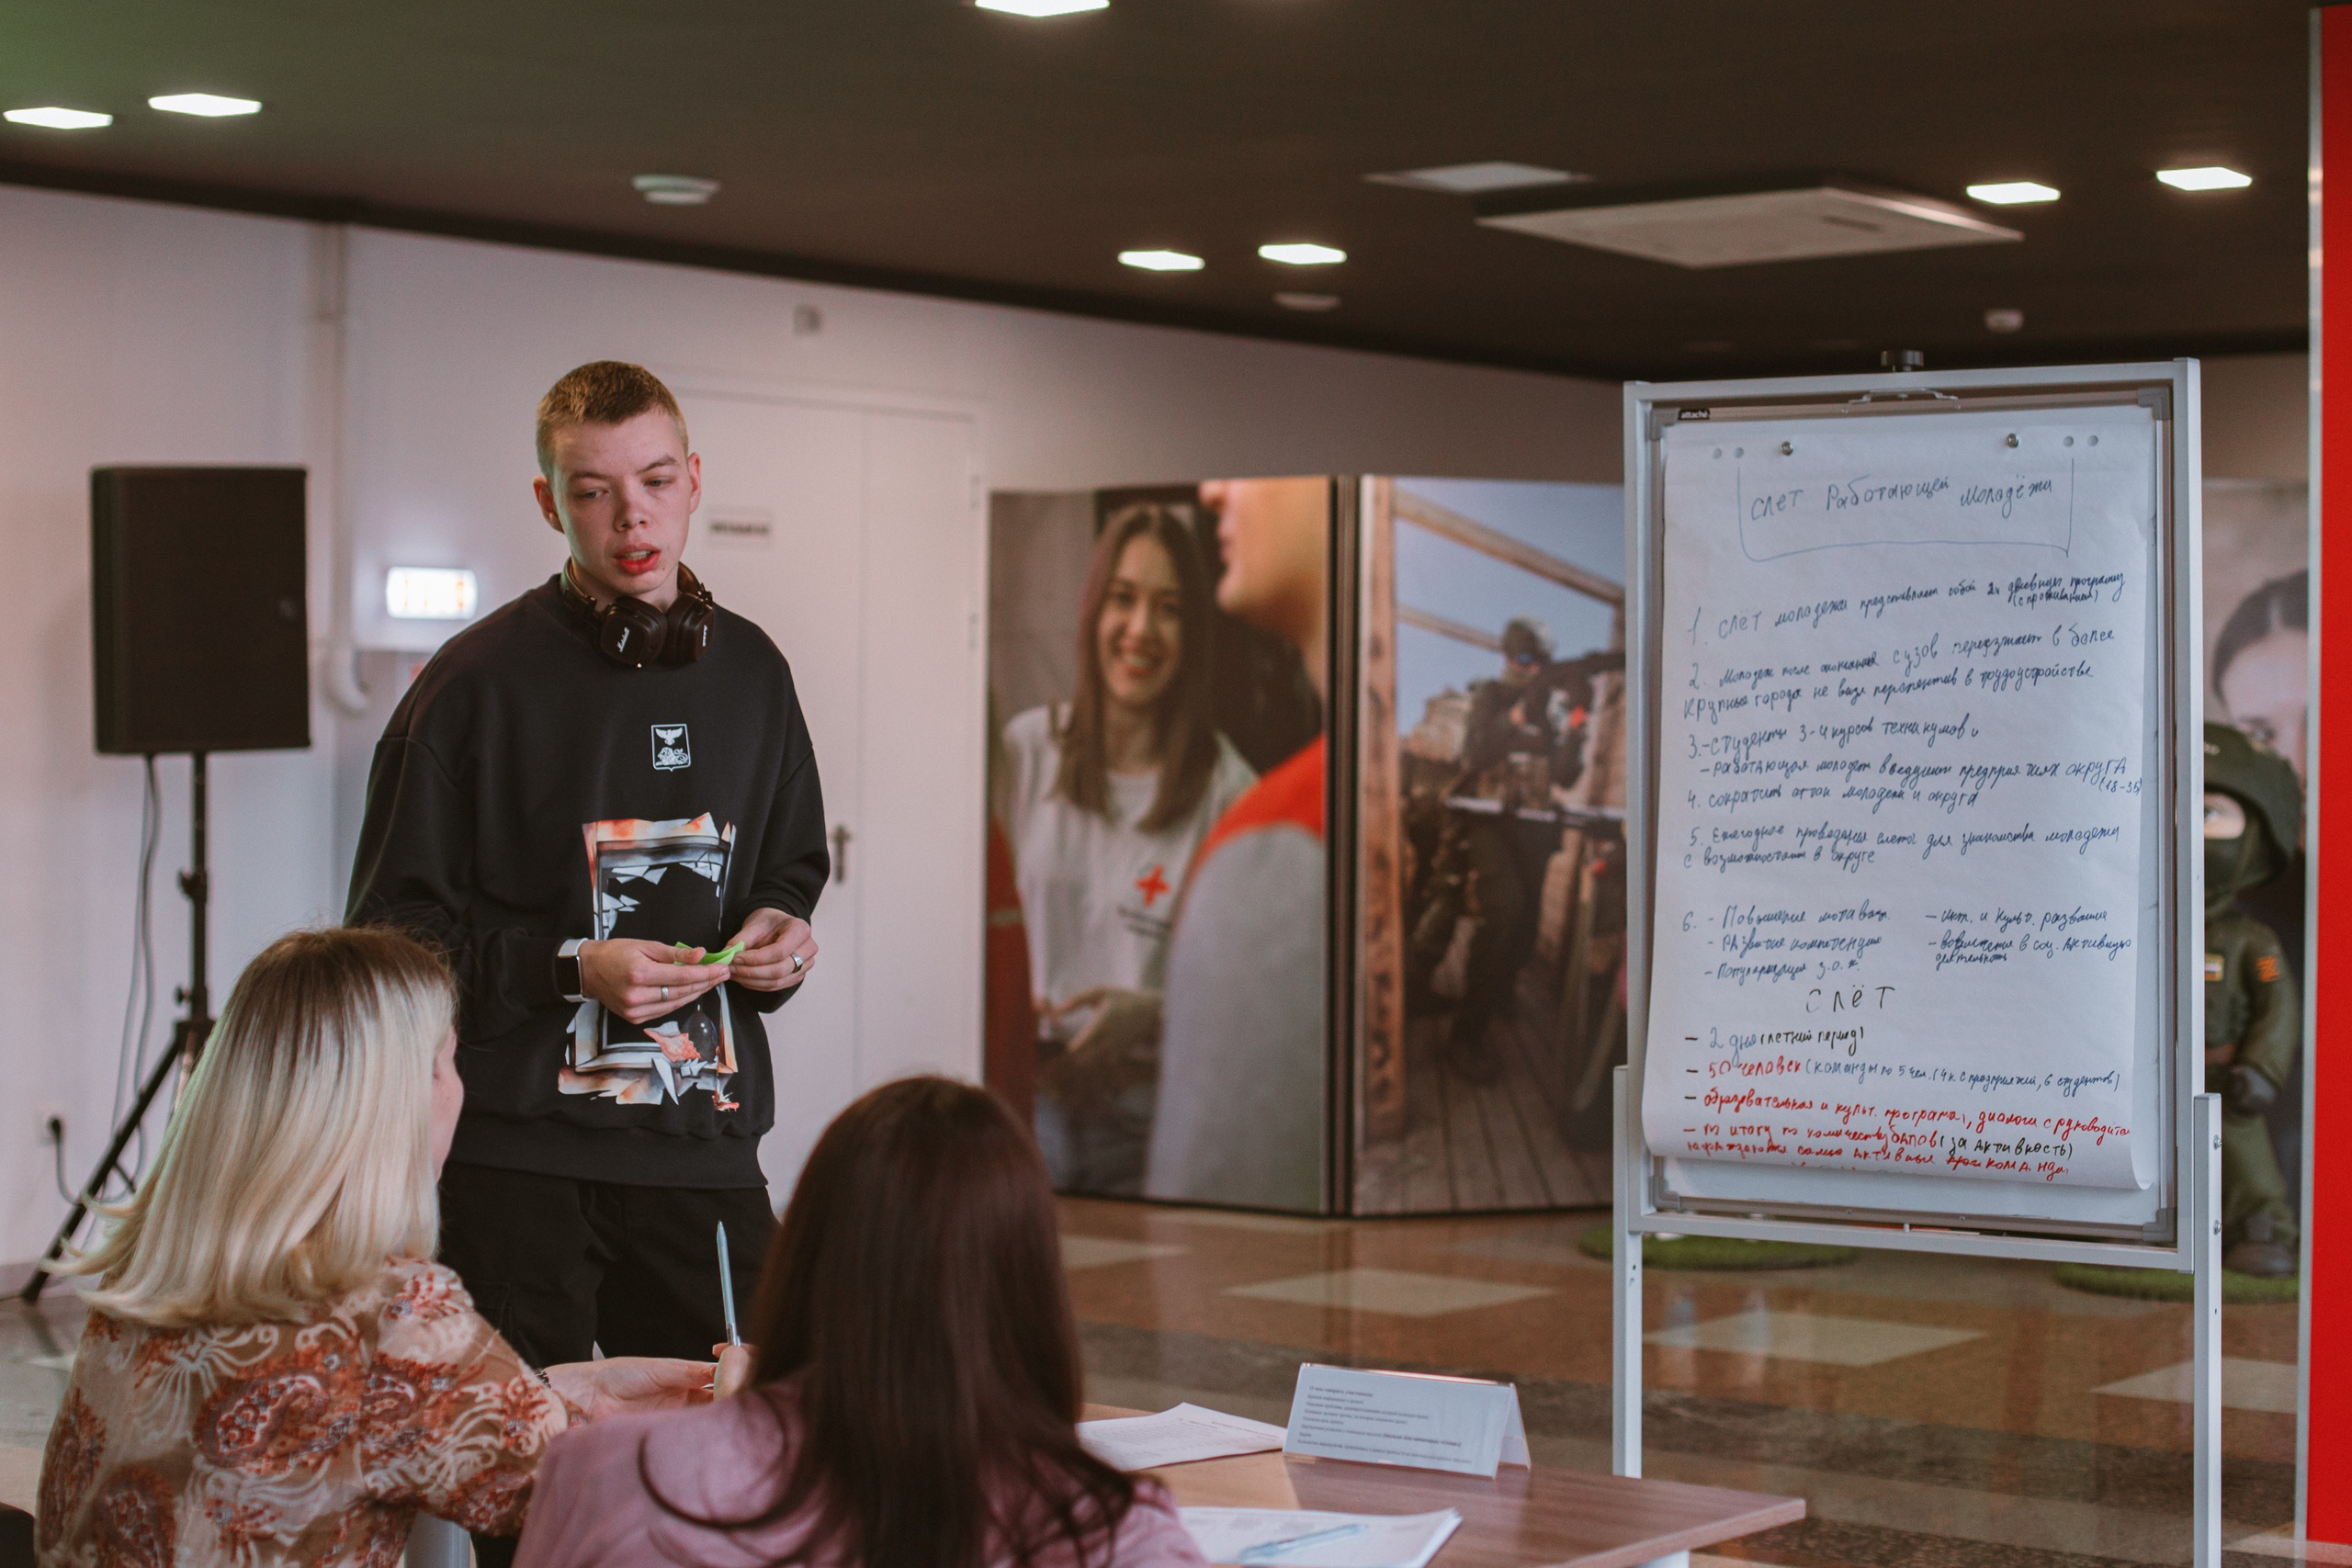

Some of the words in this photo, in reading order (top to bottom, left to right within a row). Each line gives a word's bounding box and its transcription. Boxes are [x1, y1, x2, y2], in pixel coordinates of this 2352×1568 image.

[2052, 624, 2064, 648] в
[1754, 688, 1803, 713] города
[1813, 684, 1829, 700] не
[1963, 668, 1975, 687] в
[1812, 844, 1825, 863] в
[1979, 911, 1989, 924] и
[2018, 932, 2031, 953] в
[1708, 1026, 1724, 1050] 2
